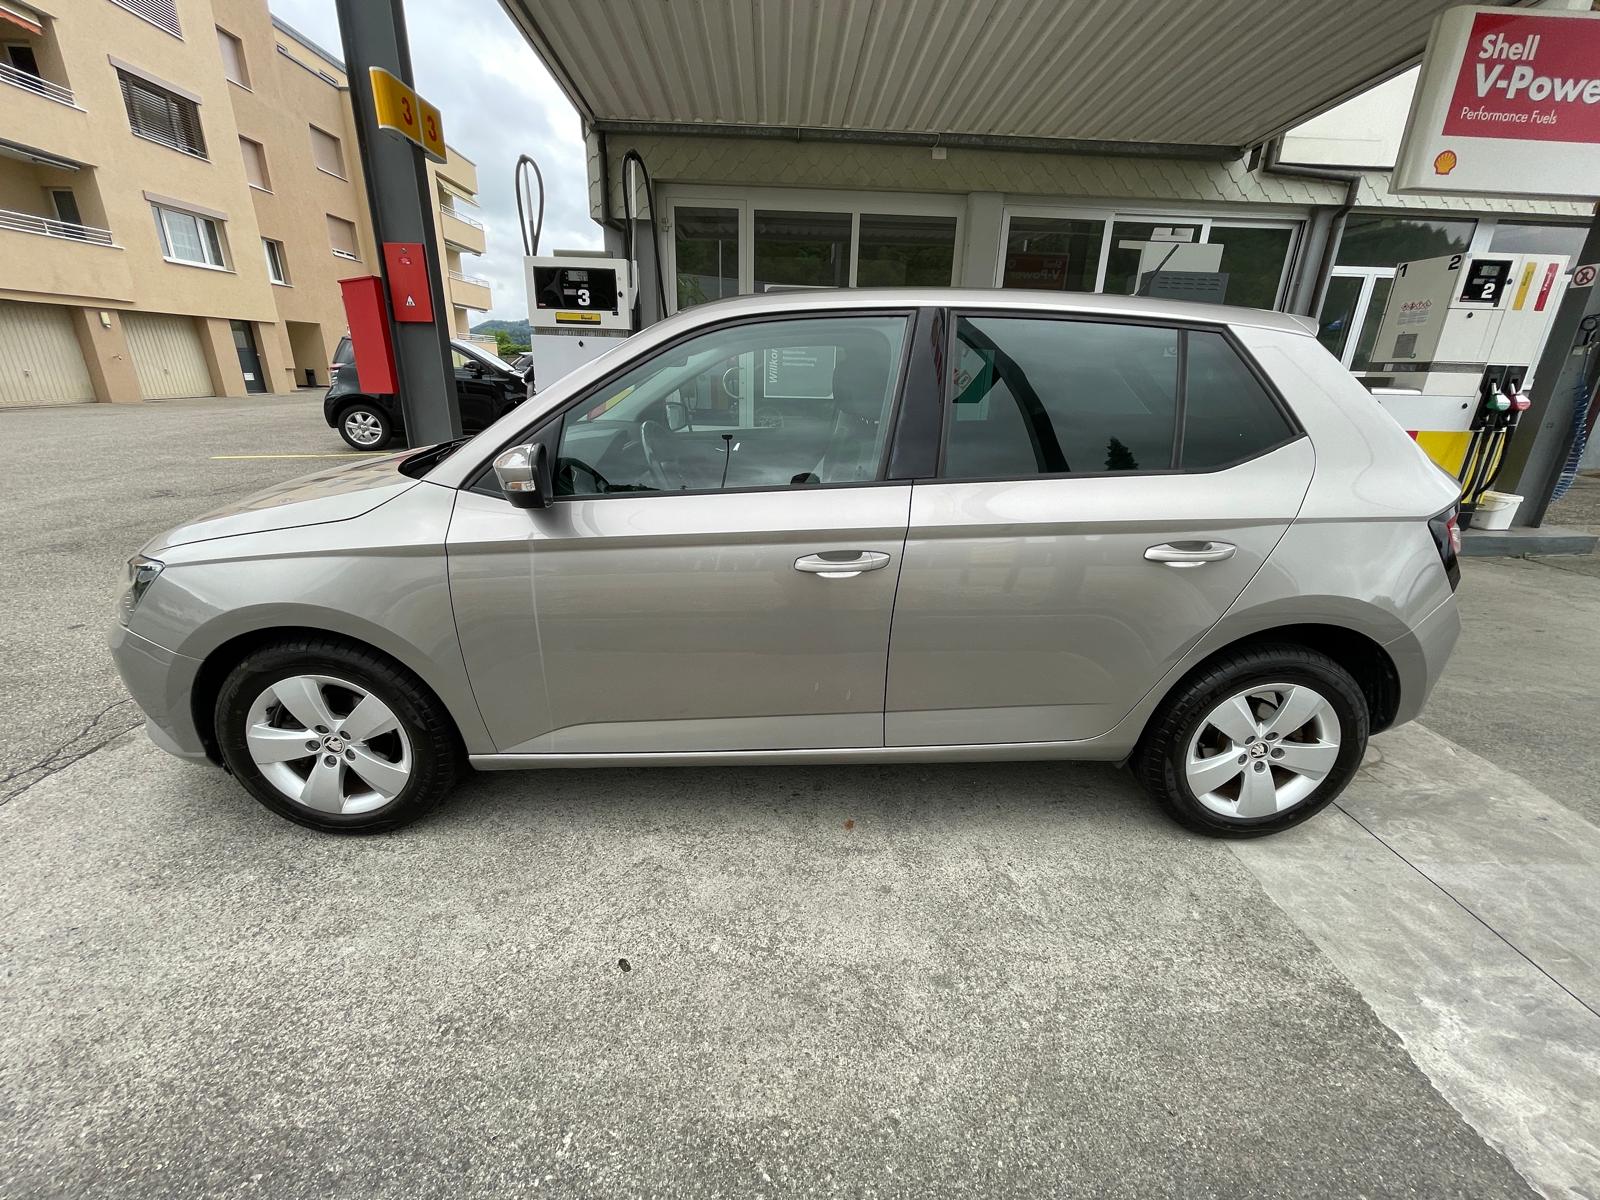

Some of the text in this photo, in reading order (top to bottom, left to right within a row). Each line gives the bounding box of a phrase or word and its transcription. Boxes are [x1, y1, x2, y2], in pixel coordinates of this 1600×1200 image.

[1478, 33, 1540, 61] Shell
[401, 97, 413, 126] 3
[1461, 106, 1558, 125] Performance Fuels
[427, 115, 437, 142] 3
[1399, 263, 1408, 277] 1
[1447, 254, 1462, 271] 2
[577, 289, 591, 306] 3
[1480, 282, 1496, 299] 2
